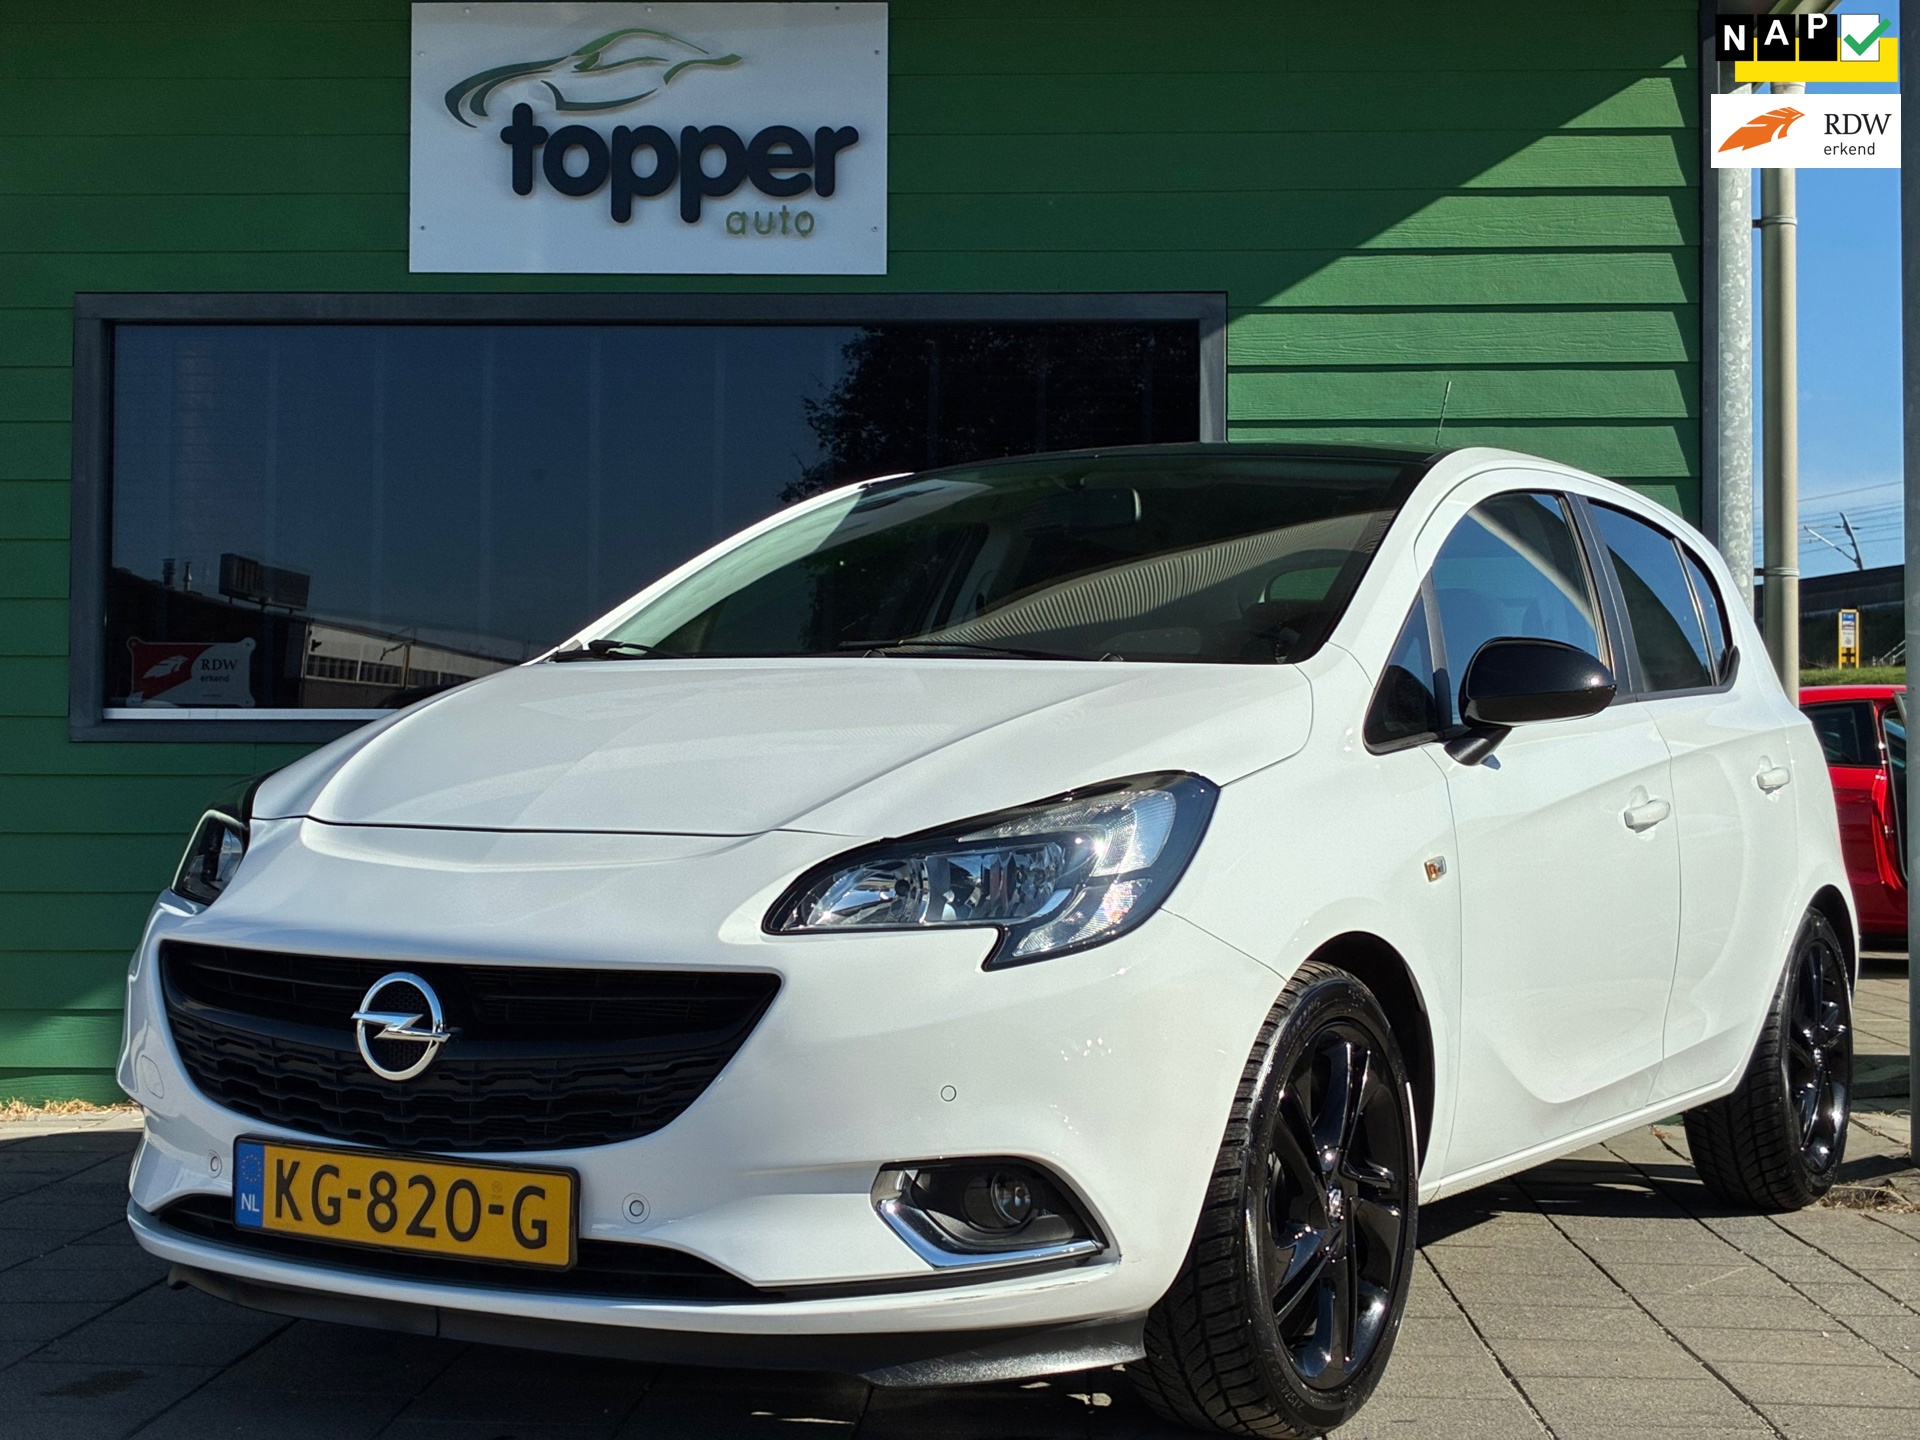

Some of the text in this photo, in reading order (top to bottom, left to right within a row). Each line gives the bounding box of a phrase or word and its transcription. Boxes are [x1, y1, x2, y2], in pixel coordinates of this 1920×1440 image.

[500, 102, 859, 224] topper
[725, 205, 815, 237] auto
[200, 658, 239, 670] RDW
[200, 673, 230, 682] erkend
[240, 1193, 260, 1213] NL
[274, 1158, 548, 1250] KG-820-G
